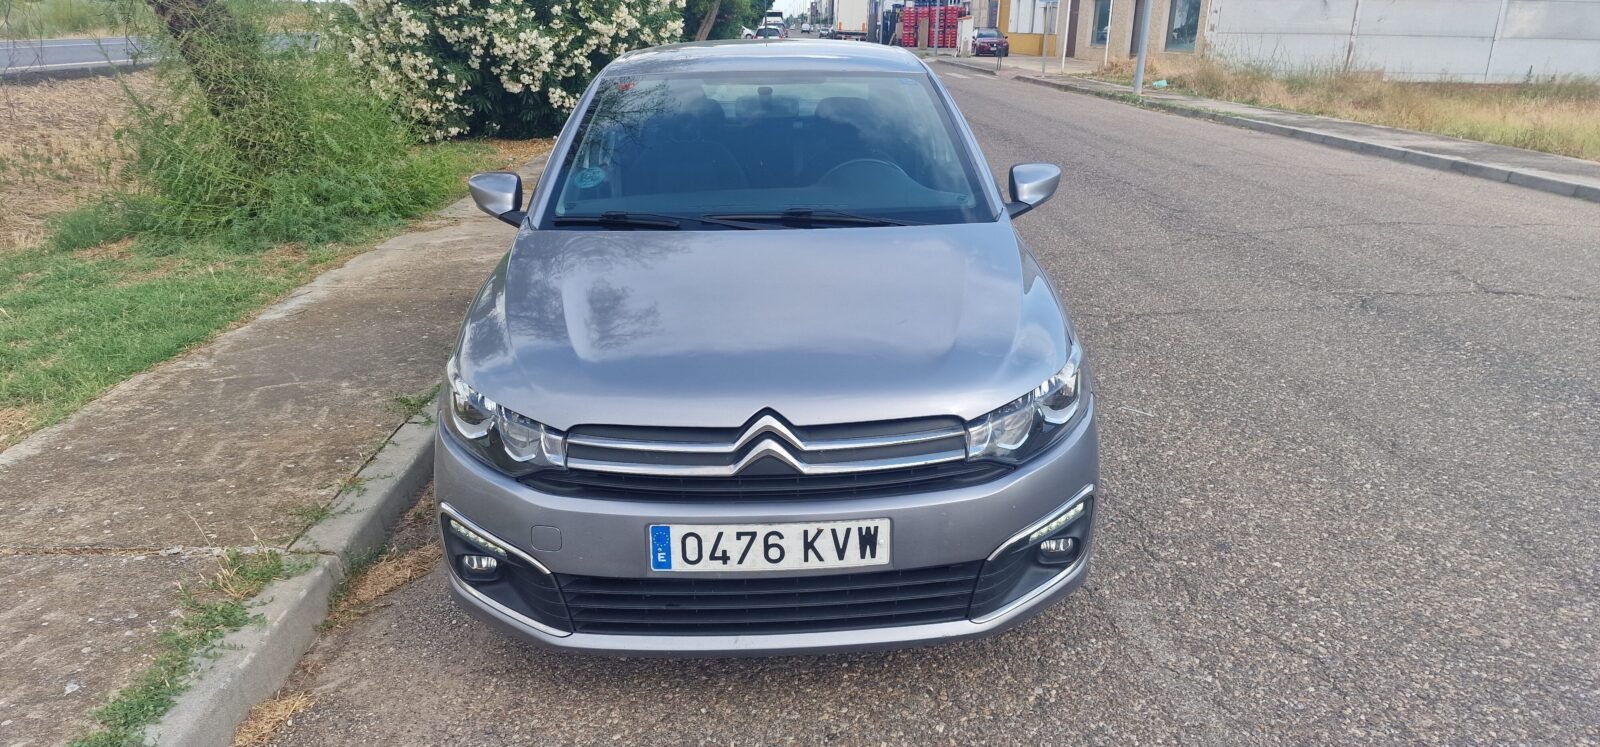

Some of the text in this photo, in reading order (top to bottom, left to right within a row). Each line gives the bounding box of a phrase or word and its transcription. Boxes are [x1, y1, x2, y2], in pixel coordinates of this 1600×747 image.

[657, 552, 667, 562] E
[680, 525, 879, 566] 0476 KVW
